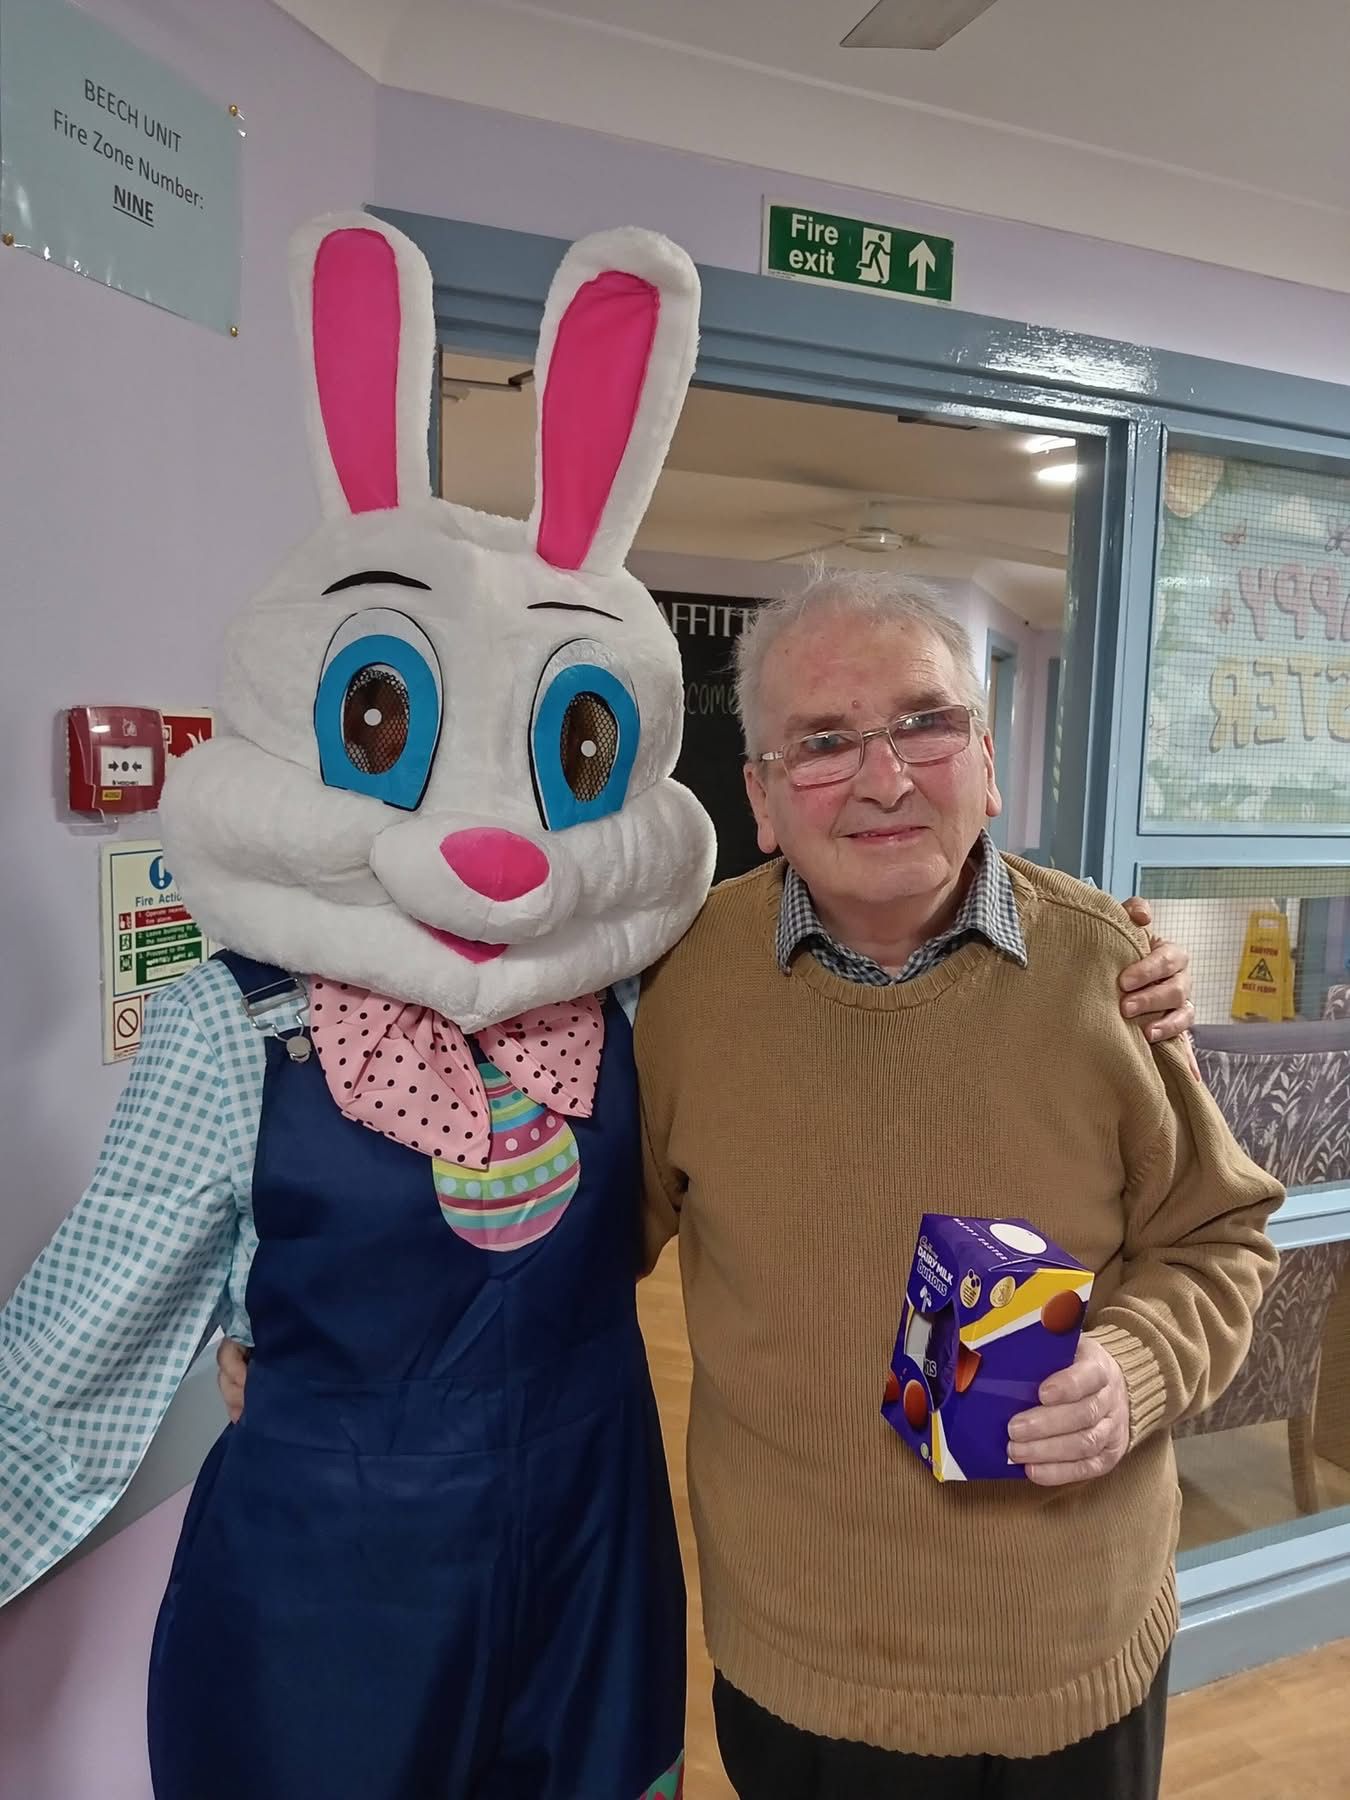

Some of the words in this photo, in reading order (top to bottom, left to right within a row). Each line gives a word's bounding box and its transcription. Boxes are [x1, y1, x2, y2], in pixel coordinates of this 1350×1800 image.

[84, 79, 139, 129] BEECH
[144, 115, 182, 153] UNIT
[53, 109, 88, 146] Fire
[93, 130, 134, 171] Zone
[139, 157, 204, 210] Number:
[113, 184, 154, 223] NINE
[791, 212, 839, 246] Fire
[788, 248, 835, 276] exit
[135, 896, 154, 907] Fire
[917, 1246, 938, 1269] DAIRY
[936, 1263, 954, 1286] MILK
[917, 1258, 948, 1297] buttons
